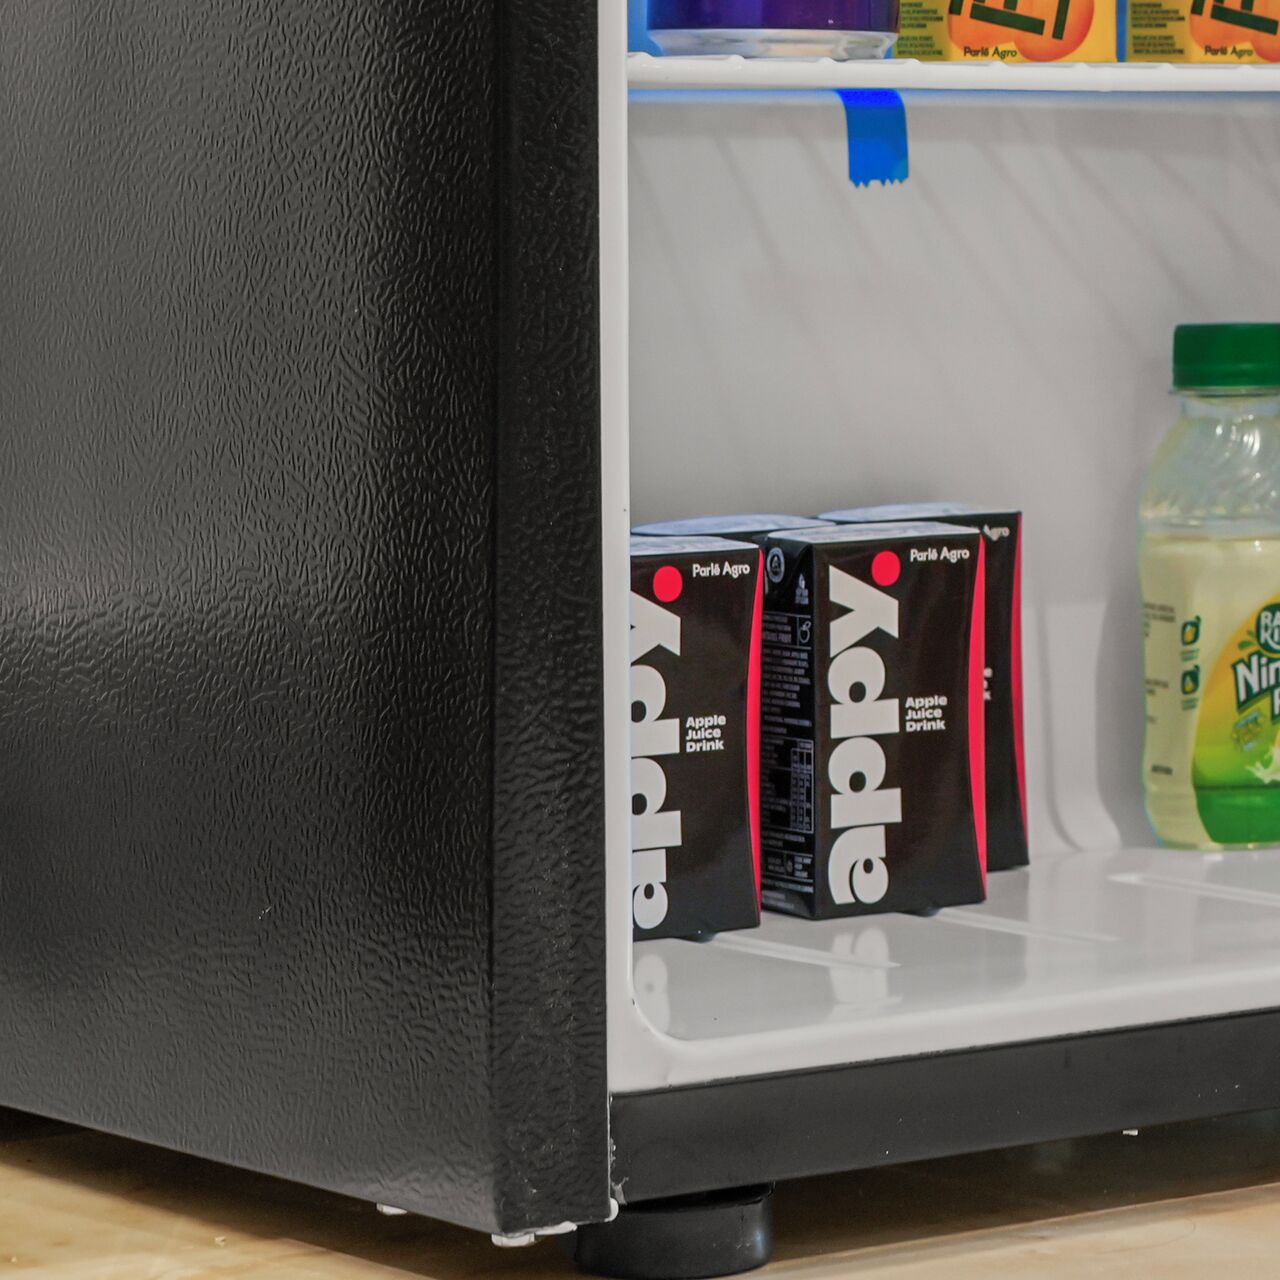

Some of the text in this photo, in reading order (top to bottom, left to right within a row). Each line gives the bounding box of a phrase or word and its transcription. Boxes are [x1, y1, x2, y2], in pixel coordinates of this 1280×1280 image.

[992, 45, 1017, 60] Agro
[940, 546, 970, 564] Agro
[722, 561, 750, 579] Agro
[905, 694, 948, 709] Apple
[905, 706, 943, 721] Juice
[686, 714, 726, 729] Apple
[906, 718, 946, 733] Drink
[686, 726, 721, 741] Juice
[827, 564, 902, 906] appy
[686, 739, 724, 753] Drink
